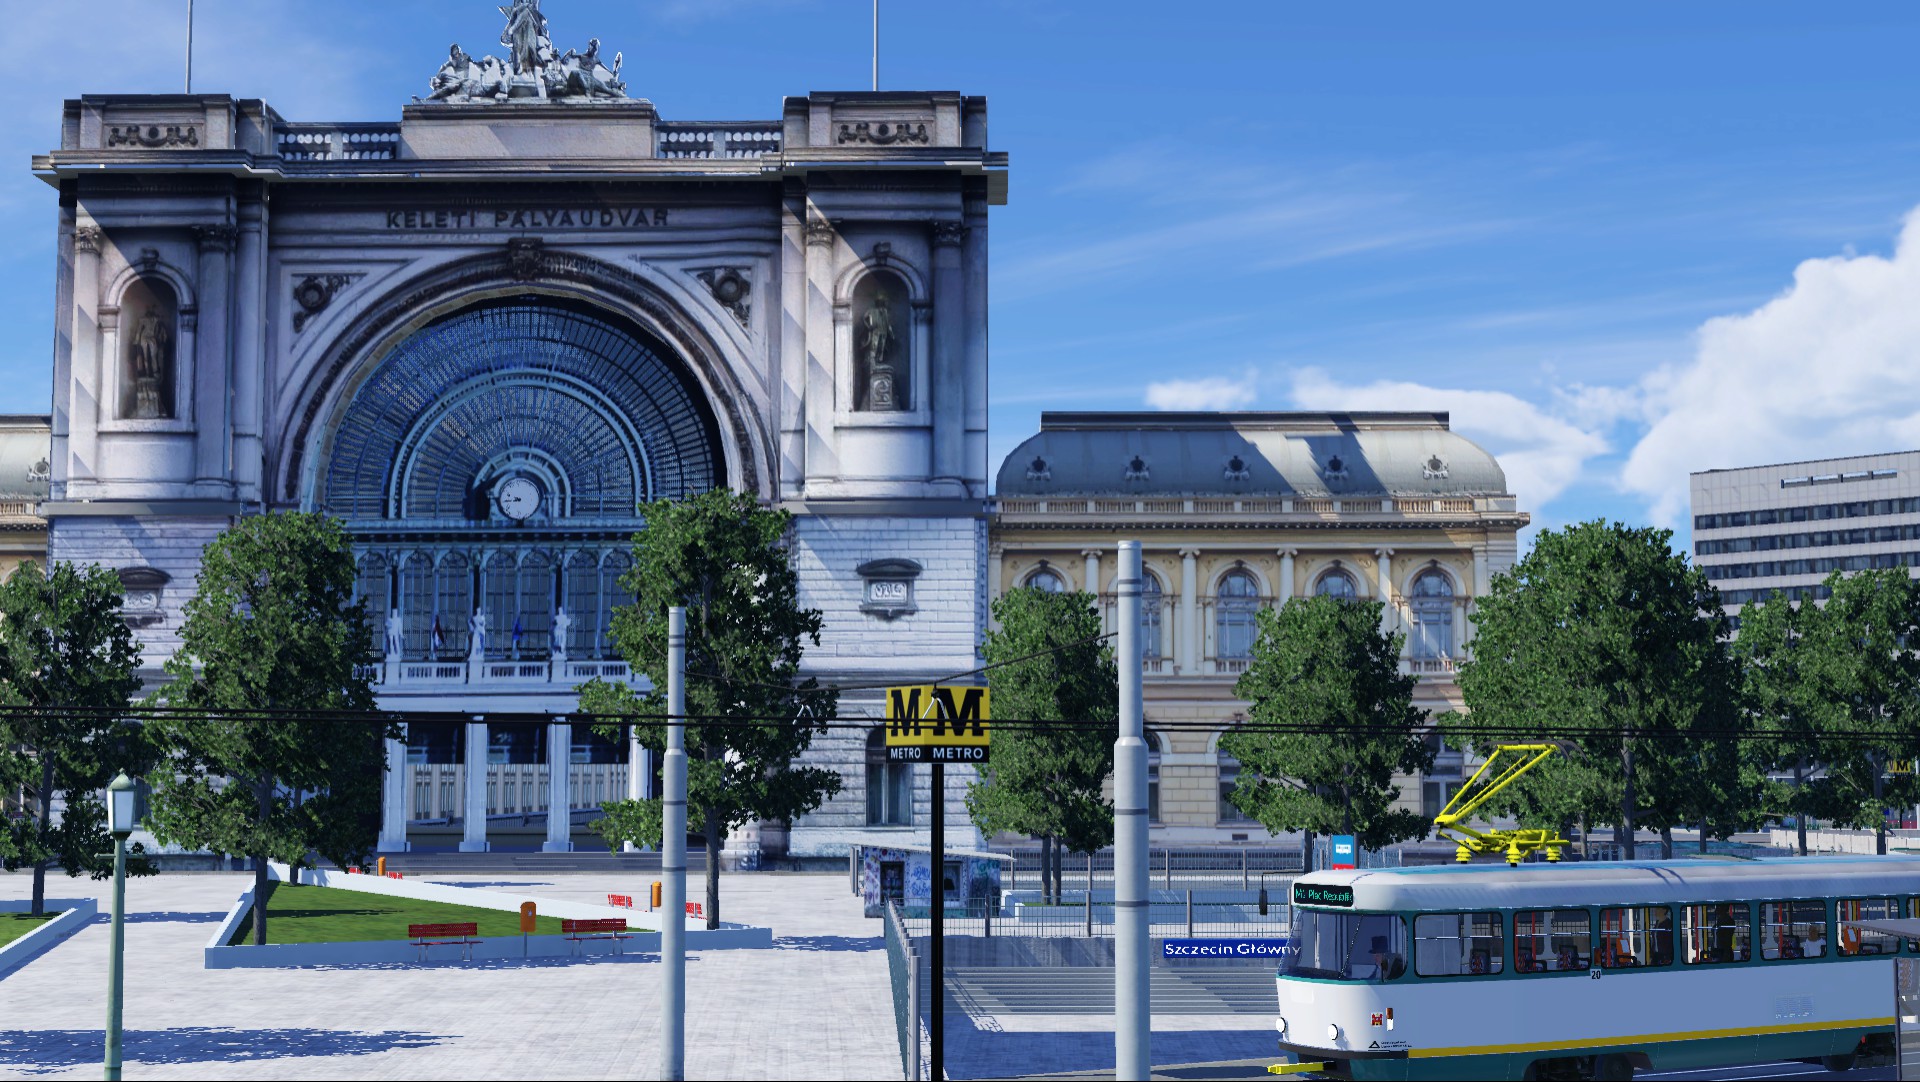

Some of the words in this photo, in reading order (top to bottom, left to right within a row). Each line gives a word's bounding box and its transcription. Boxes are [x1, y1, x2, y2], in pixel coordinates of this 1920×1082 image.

[386, 210, 475, 229] KELETI
[891, 688, 922, 737] M
[932, 688, 984, 737] M
[890, 747, 921, 760] METRO
[933, 747, 983, 760] METRO
[1165, 943, 1233, 955] Szczecin
[1236, 943, 1302, 956] Główny
[1591, 970, 1601, 980] 20
